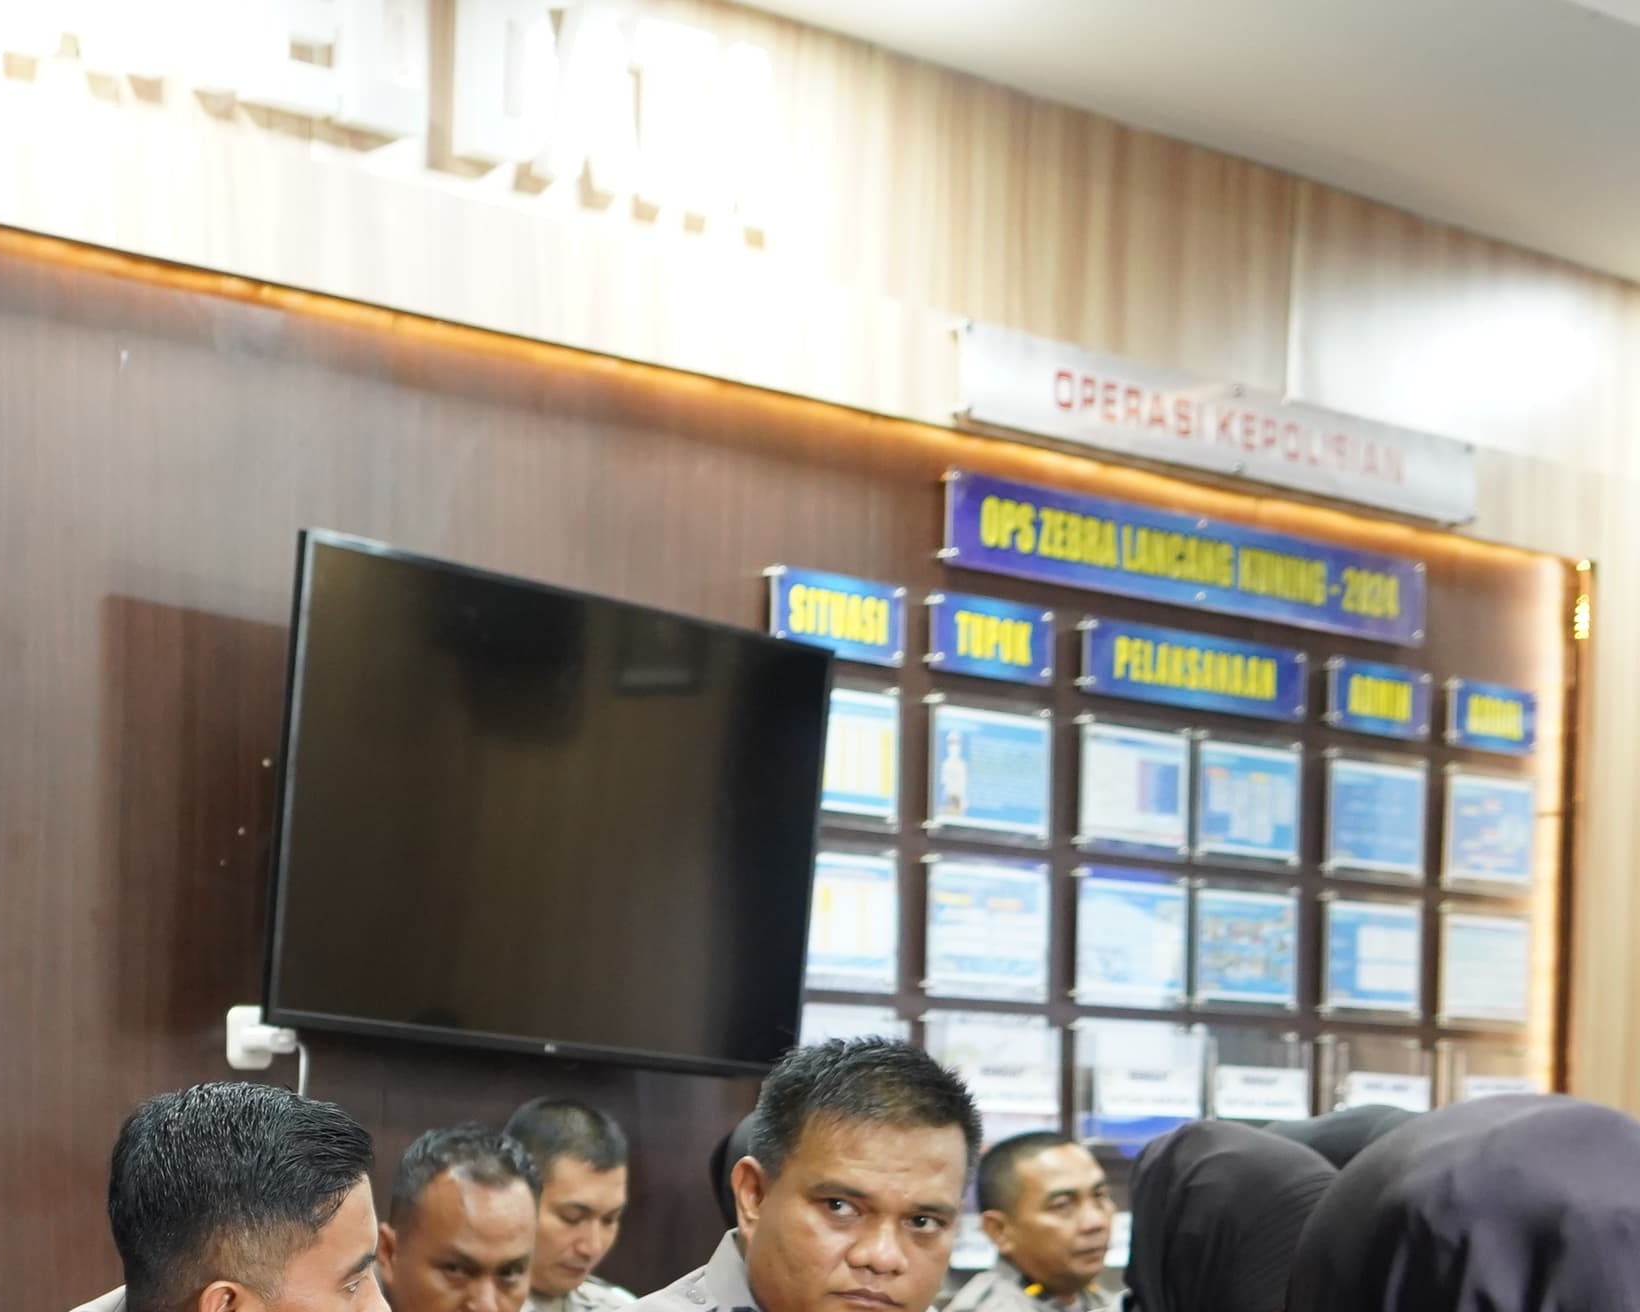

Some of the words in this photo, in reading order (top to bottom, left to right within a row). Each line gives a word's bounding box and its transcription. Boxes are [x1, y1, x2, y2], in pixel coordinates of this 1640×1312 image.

[1054, 369, 1206, 440] OPERASI
[1215, 406, 1405, 485] KEPOLISIAN
[980, 496, 1036, 554] OPS
[1039, 508, 1118, 569] ZEBRA
[1122, 524, 1234, 588] LANCANG
[1239, 546, 1326, 607] KUNING
[1342, 567, 1400, 620] 2024
[788, 583, 889, 645] SITUASI
[1113, 636, 1278, 701] PELAKSANAAN
